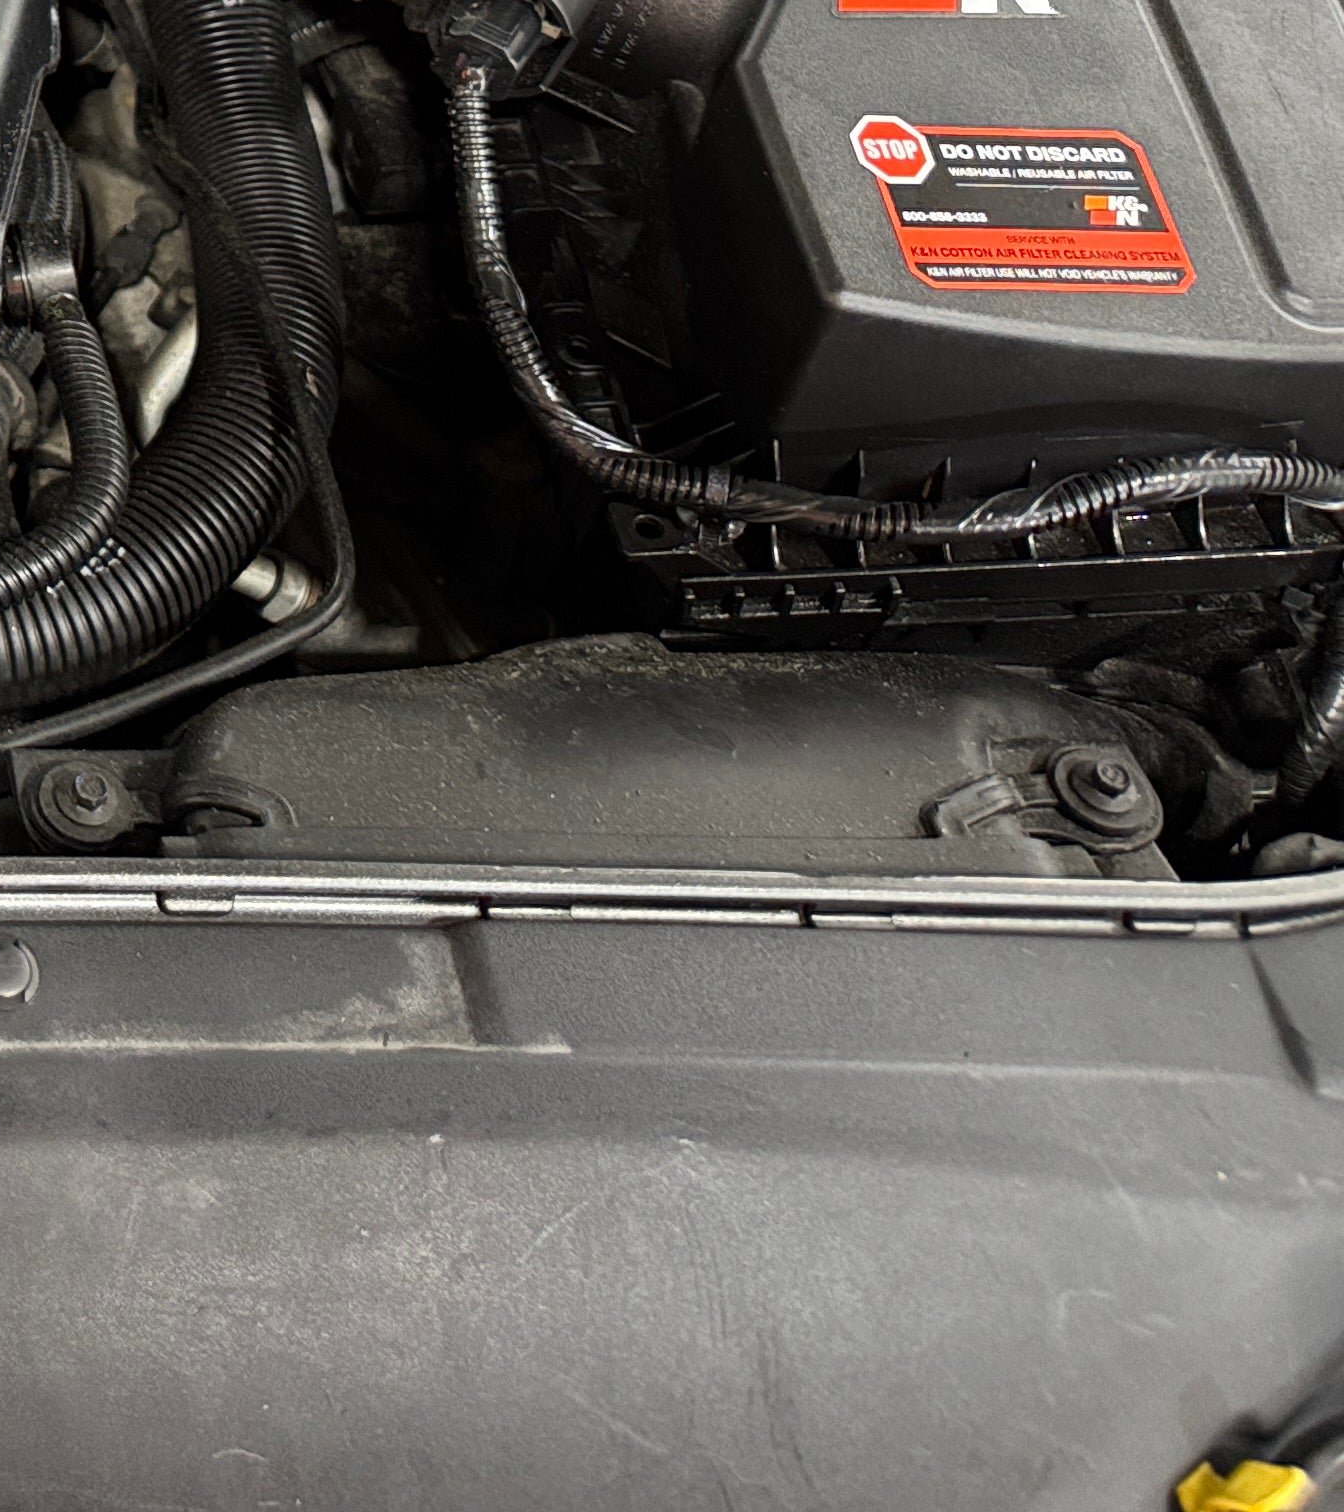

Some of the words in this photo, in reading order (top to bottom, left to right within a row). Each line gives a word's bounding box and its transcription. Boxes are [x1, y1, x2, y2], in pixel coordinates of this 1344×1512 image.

[862, 138, 919, 161] STOP
[938, 144, 974, 160] DO
[976, 144, 1023, 161] NOT
[1028, 145, 1127, 163] DISCARD
[948, 166, 1011, 179] WASHABLE
[1017, 167, 1076, 180] REUSABLE
[1077, 169, 1096, 180] AIR
[1096, 170, 1134, 181] FILTER
[1006, 235, 1047, 244] SERVICE
[1049, 236, 1075, 244] WITH
[910, 246, 938, 258] K&N
[940, 247, 993, 259] COTTON
[996, 248, 1017, 259] AIR
[1020, 249, 1062, 260] FILTER
[1063, 249, 1127, 261] CLEANING
[1128, 251, 1181, 262] SYSTEM
[948, 266, 964, 278] AIR
[964, 267, 994, 279] FILTER
[995, 267, 1014, 279] USE
[1014, 267, 1038, 280] WILL
[1038, 268, 1058, 280] NOT
